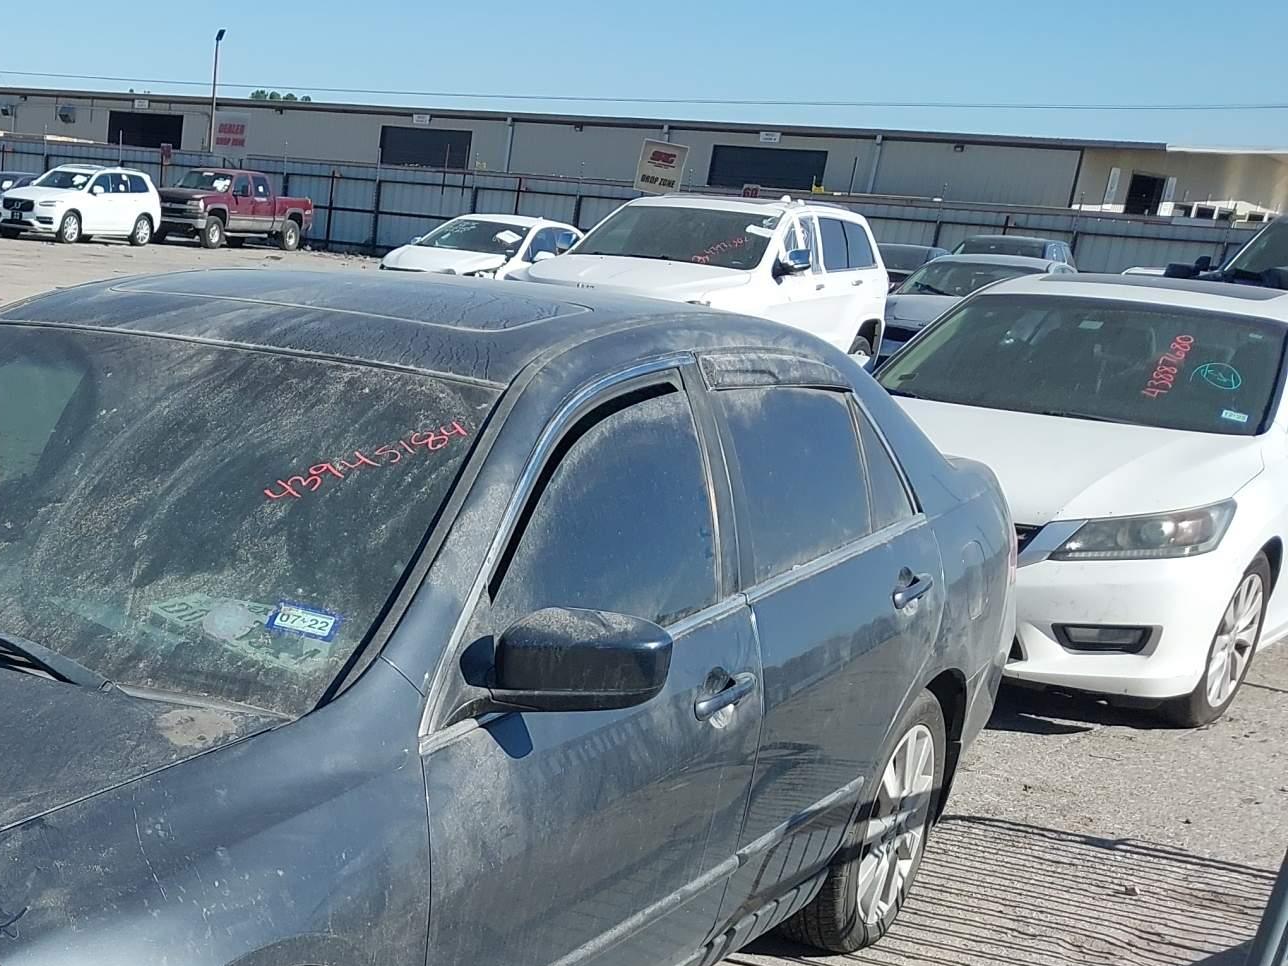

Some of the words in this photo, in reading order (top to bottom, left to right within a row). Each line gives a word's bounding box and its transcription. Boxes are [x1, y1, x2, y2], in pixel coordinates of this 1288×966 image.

[640, 174, 659, 184] DROP
[659, 177, 676, 188] ZONE
[1142, 334, 1194, 398] 43887680
[264, 421, 468, 498] 43945184
